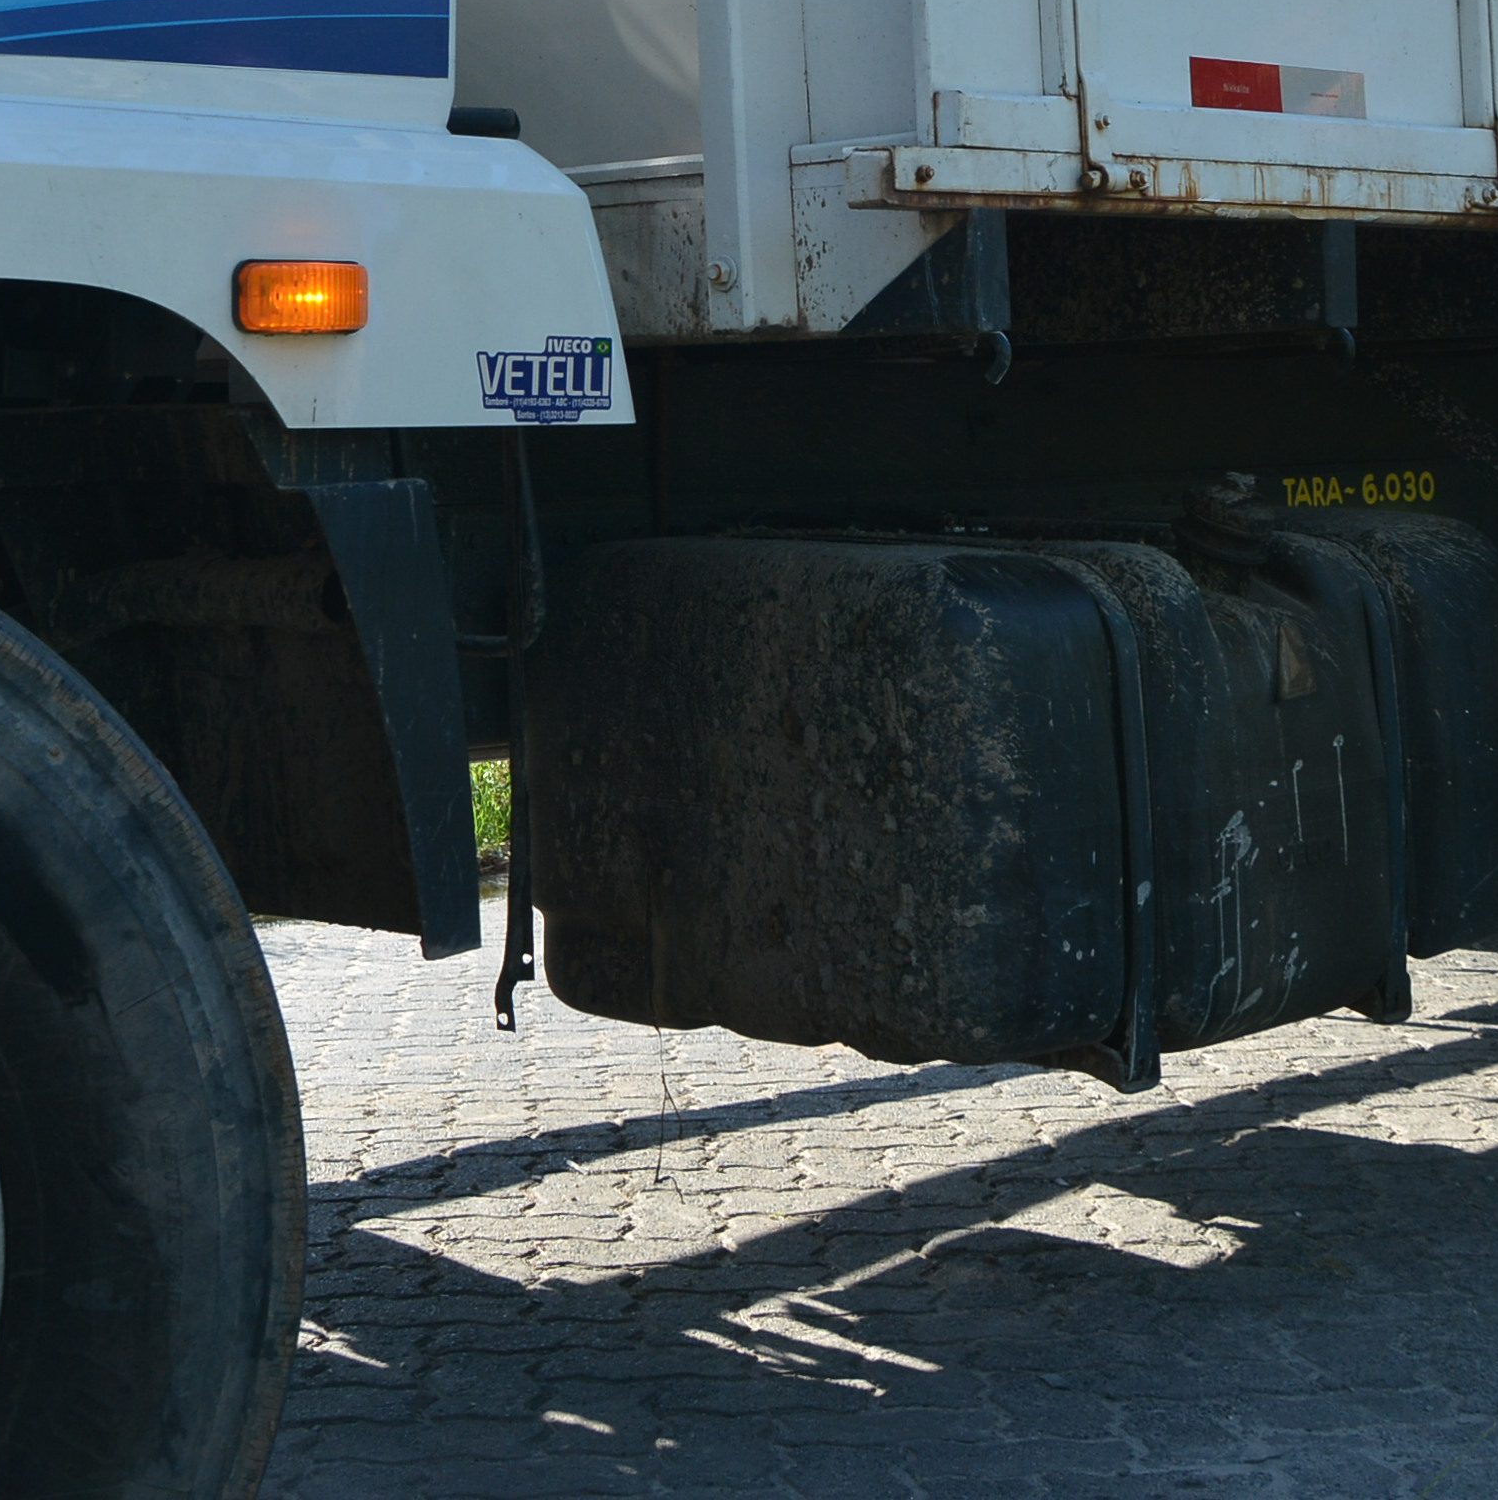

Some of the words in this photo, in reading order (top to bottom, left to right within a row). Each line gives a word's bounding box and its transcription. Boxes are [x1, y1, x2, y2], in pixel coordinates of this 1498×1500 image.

[548, 339, 592, 354] IVECO
[478, 354, 610, 397] VETELLI
[1362, 470, 1435, 505] 6.030
